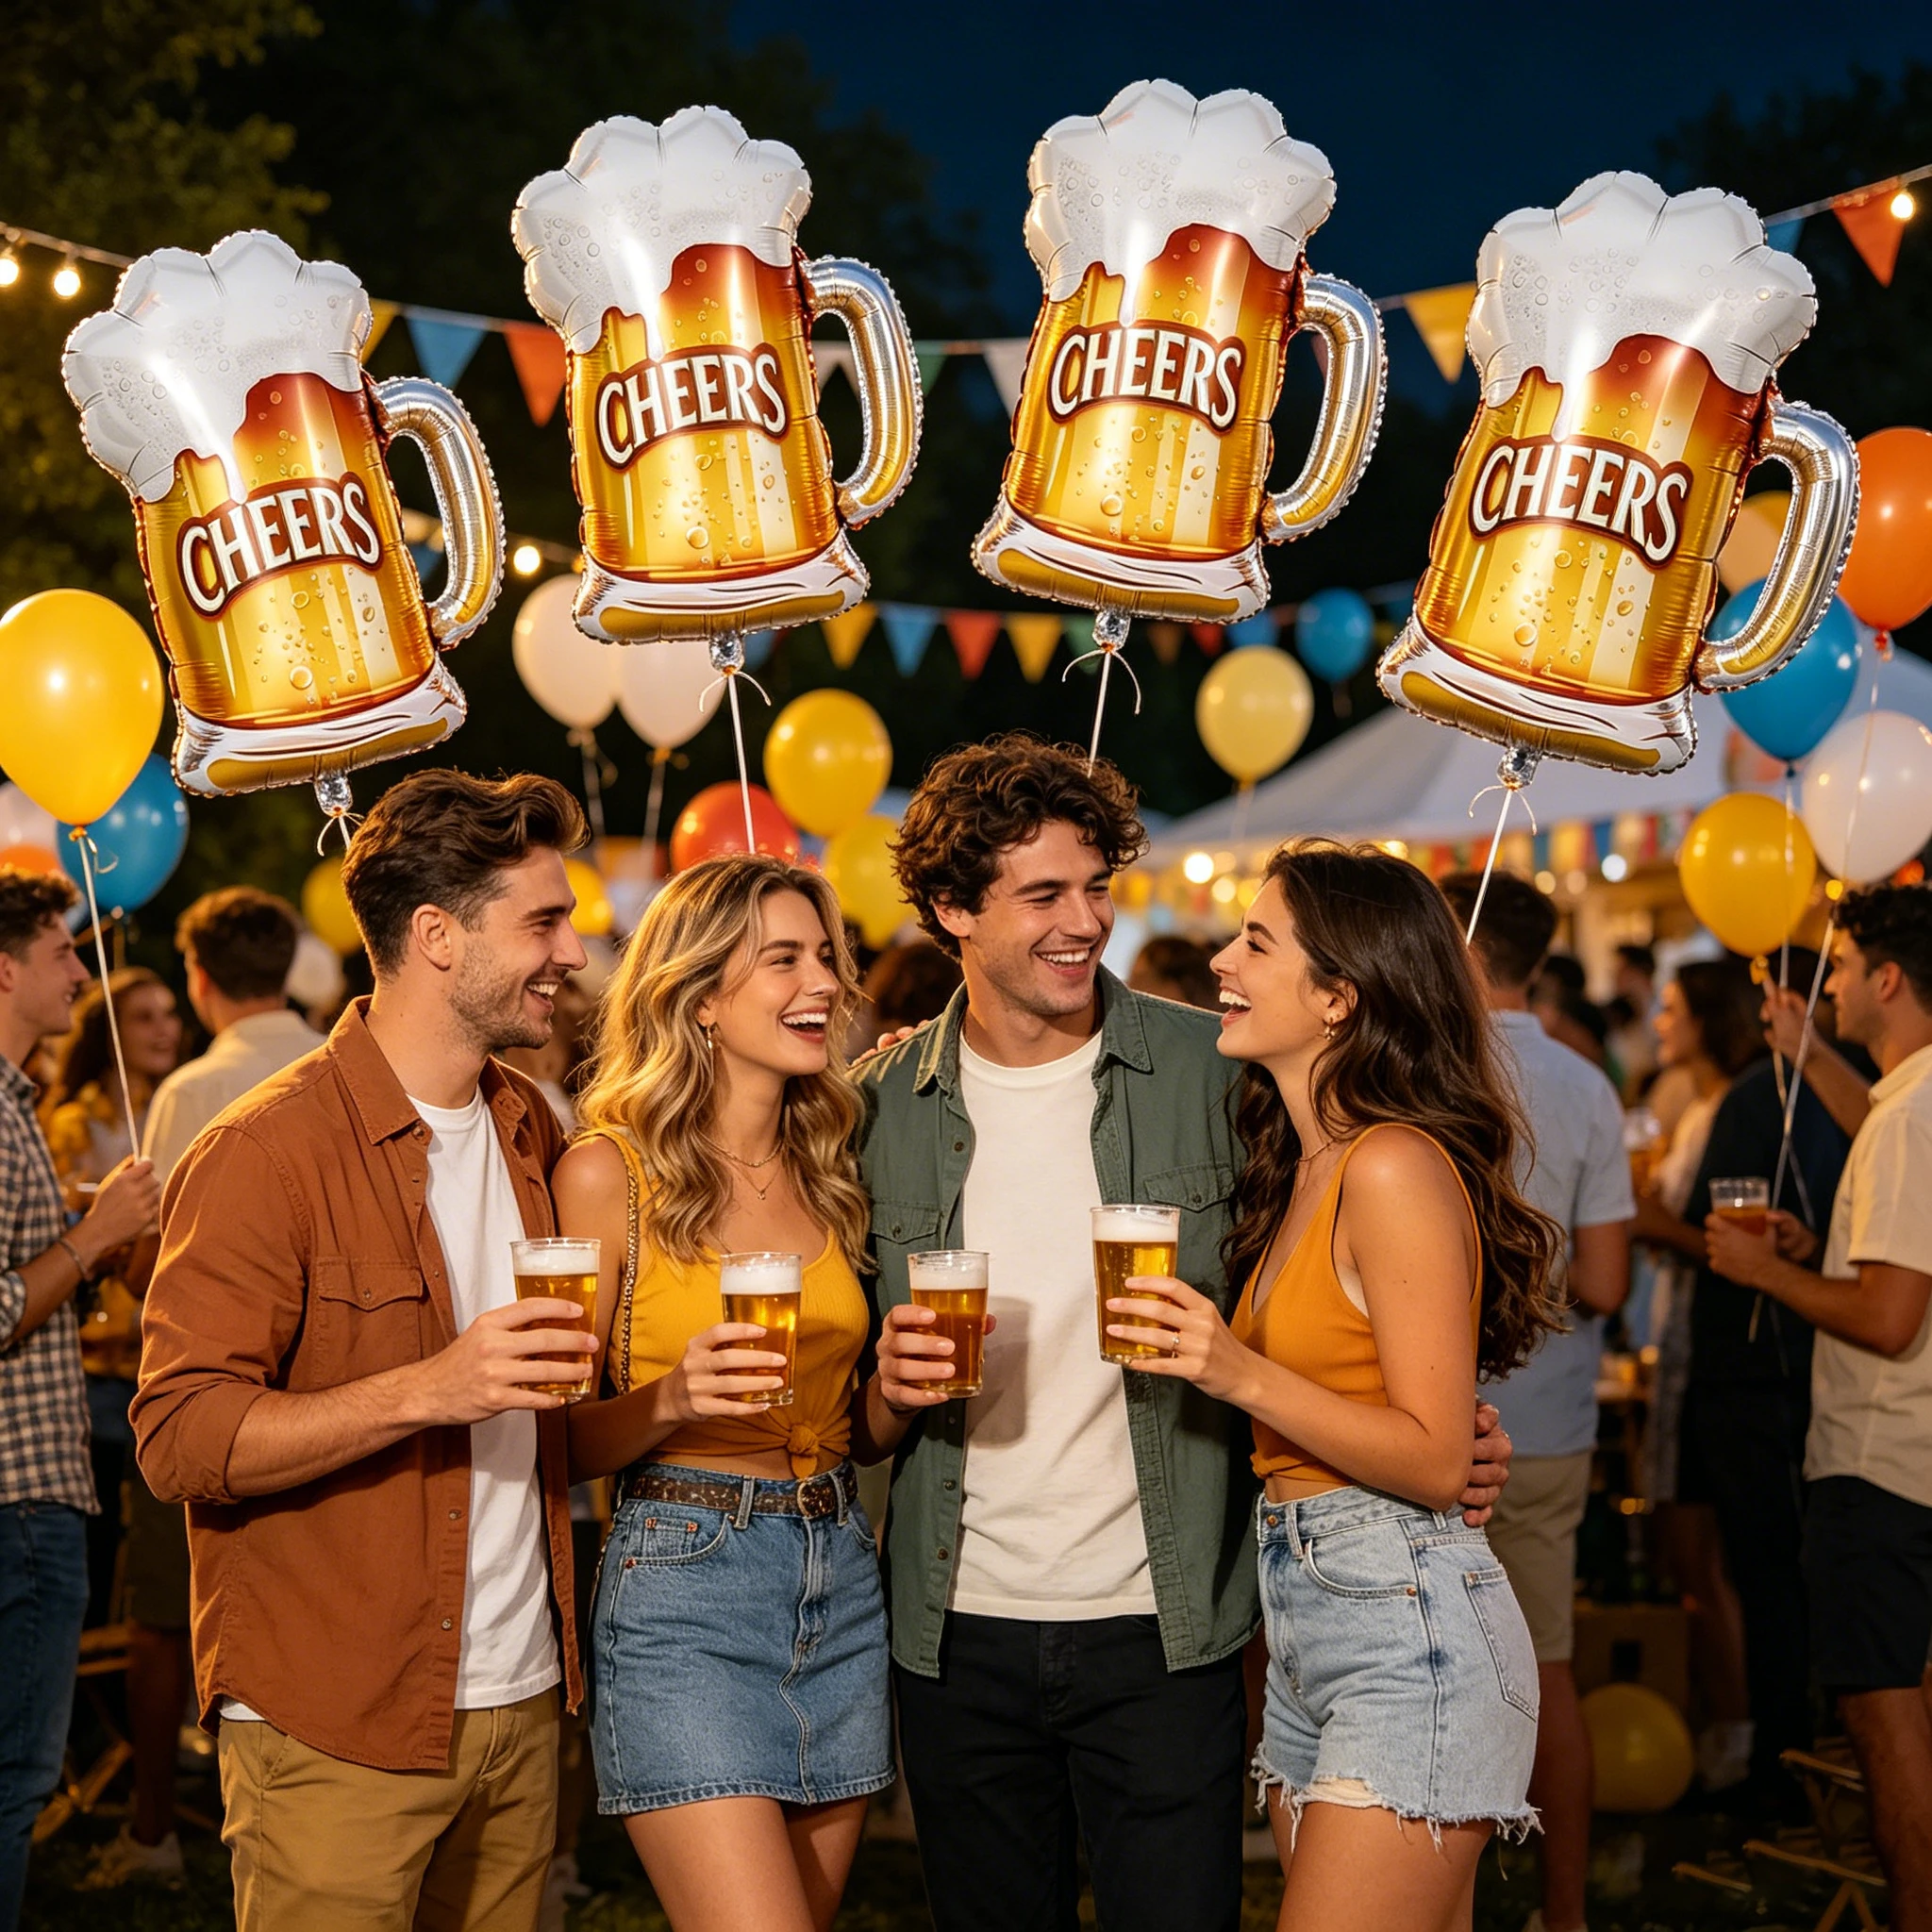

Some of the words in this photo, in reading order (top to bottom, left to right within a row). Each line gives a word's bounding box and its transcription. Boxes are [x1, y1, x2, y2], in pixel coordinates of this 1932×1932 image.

[598, 353, 786, 464] CHEERS
[1051, 328, 1241, 427] CHEERS
[181, 481, 379, 612] CHEERS
[1473, 443, 1687, 561] CHEERS
